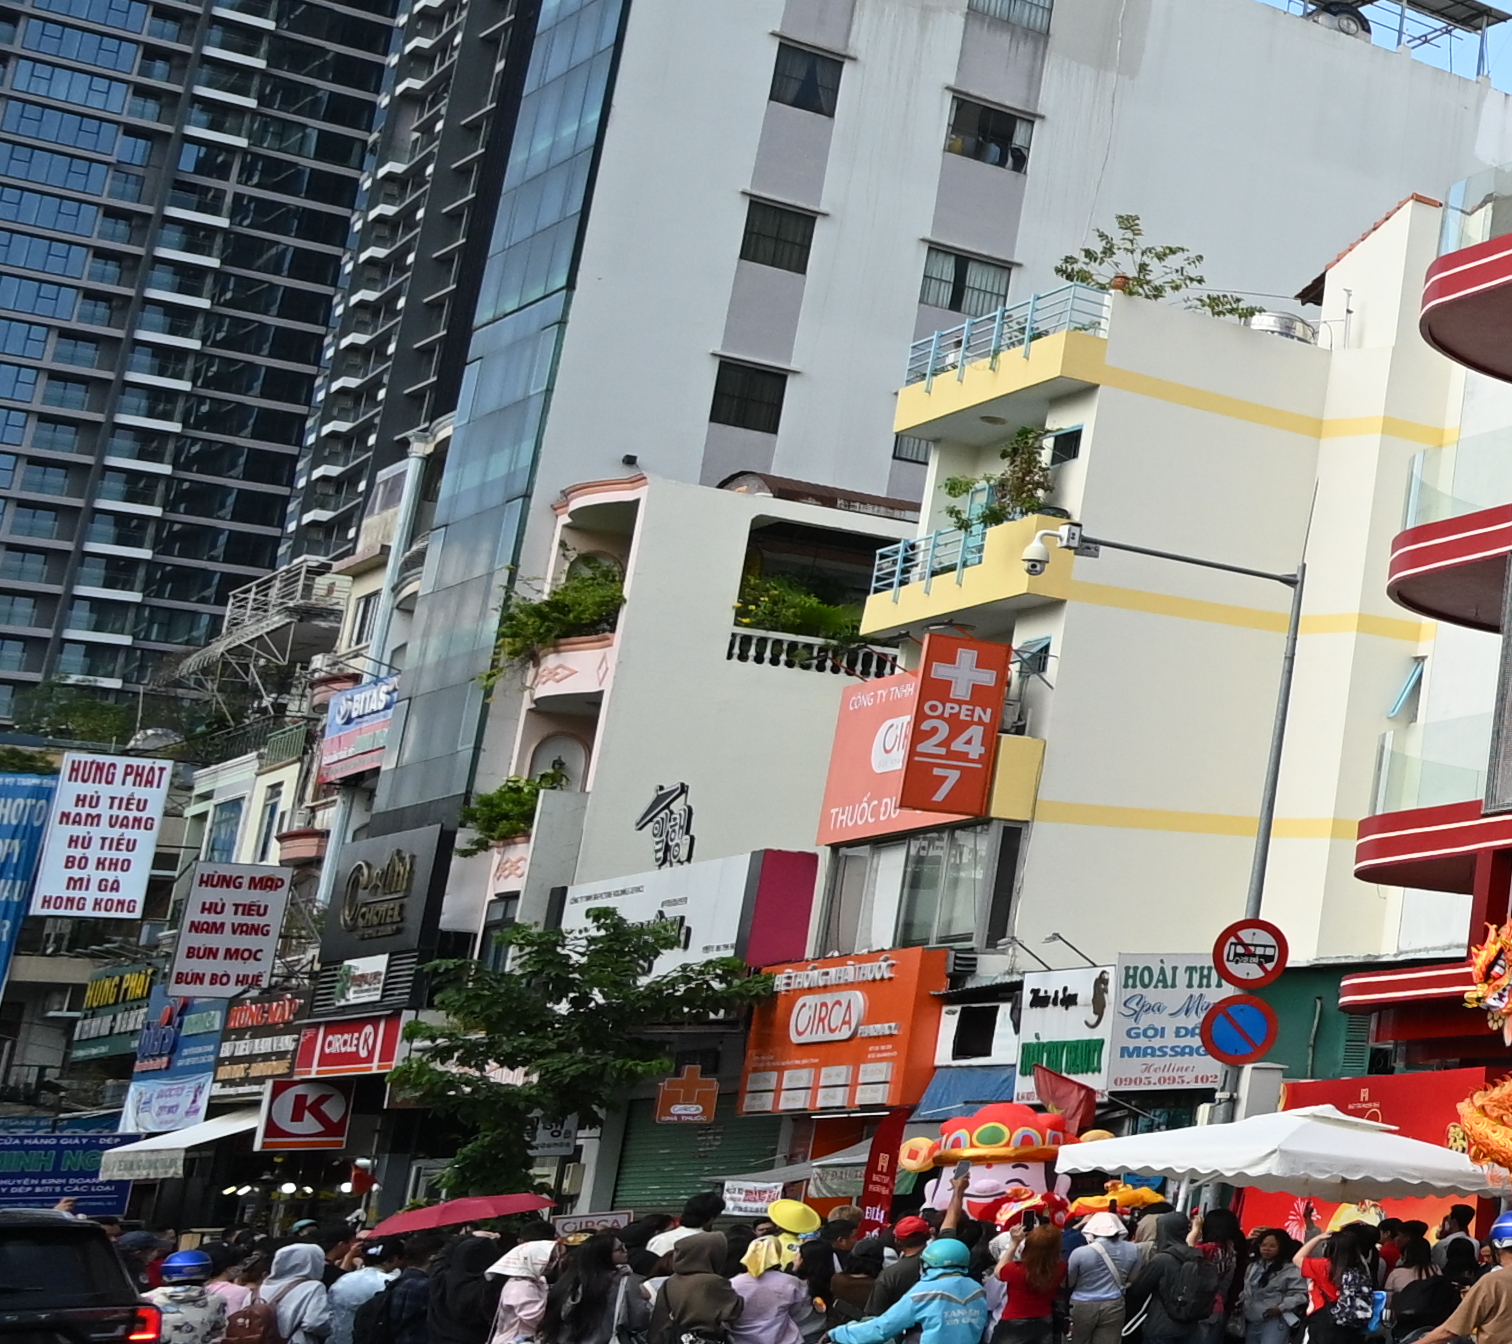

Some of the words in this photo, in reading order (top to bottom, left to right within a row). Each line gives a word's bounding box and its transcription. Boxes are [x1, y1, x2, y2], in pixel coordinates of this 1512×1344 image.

[849, 690, 874, 711] CÔNG
[876, 688, 890, 703] TY
[889, 682, 915, 701] TNHH
[924, 700, 991, 723] OPEN
[916, 718, 985, 760] 24
[931, 767, 961, 802] 7
[75, 792, 101, 809] HỦ
[108, 791, 148, 812] TIẾU
[58, 811, 101, 828] NAM
[108, 813, 155, 831] VANG
[67, 831, 92, 850] HỦ
[100, 833, 137, 852] TIẾU
[198, 872, 244, 890] HÙNG
[248, 874, 285, 894] MẬP
[40, 895, 86, 912] HONG
[92, 897, 137, 914] KONG
[188, 920, 225, 935] NAM
[231, 922, 271, 937] VANG
[185, 945, 219, 960] BÚN
[223, 947, 264, 964] MỌC
[175, 970, 205, 986] BÚN
[209, 970, 230, 986] BÒ
[235, 969, 266, 987] HUẾ
[1140, 1063, 1195, 1074] Hotline:
[1113, 1073, 1218, 1087] 0905.095.402
